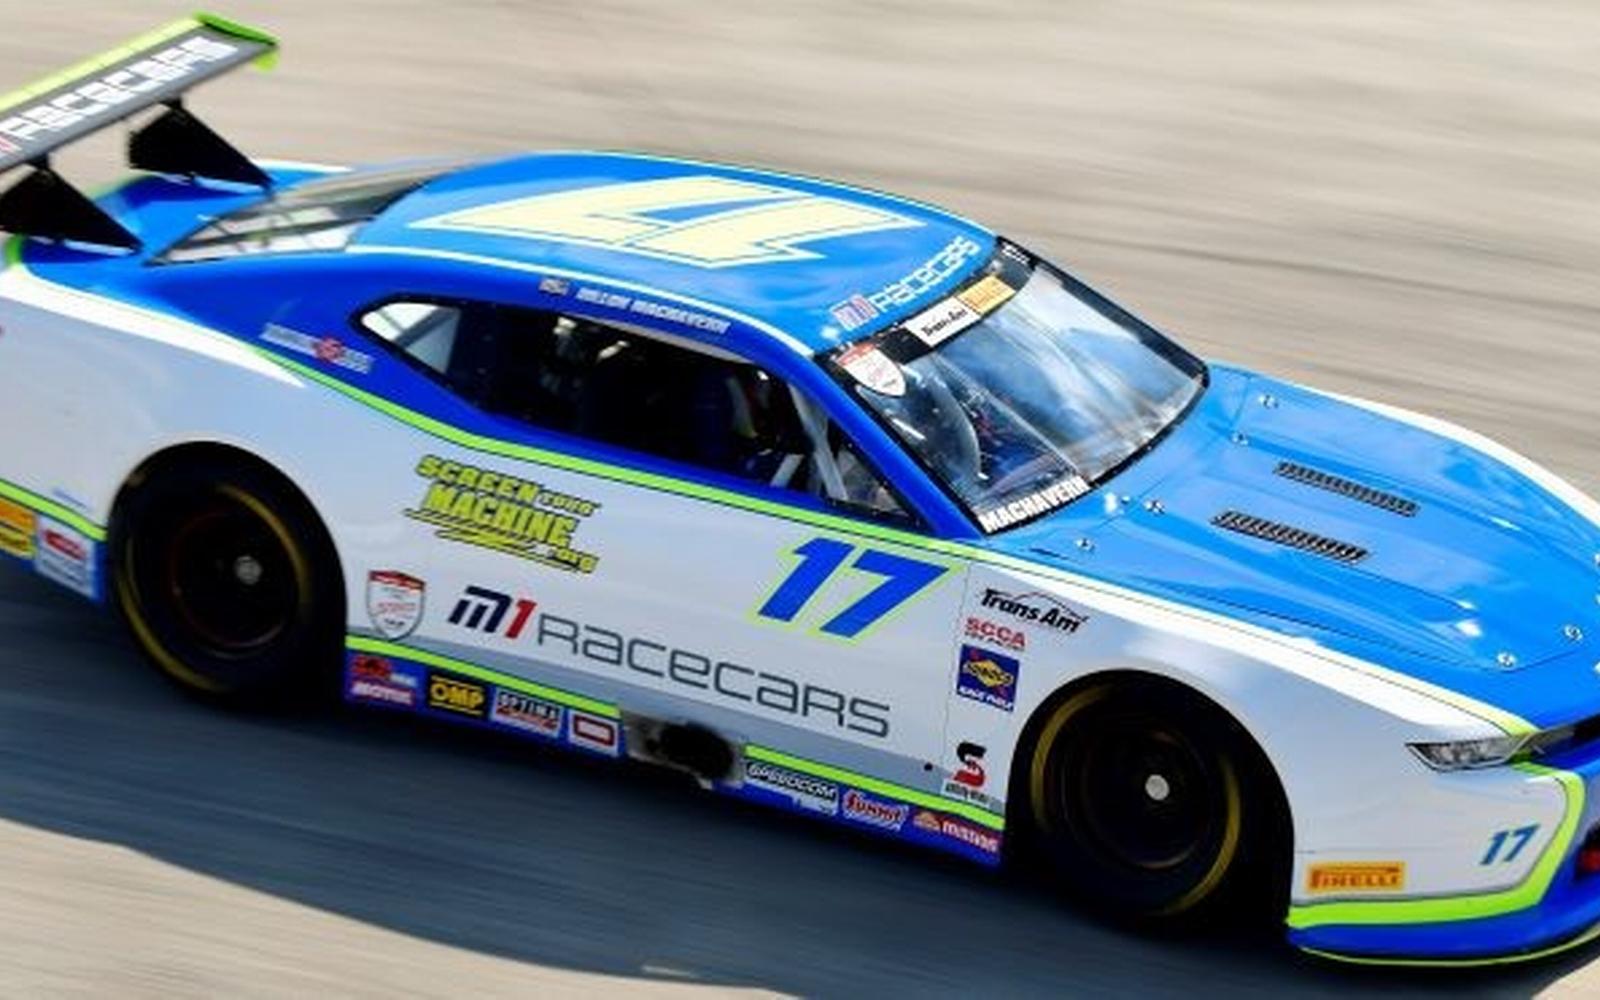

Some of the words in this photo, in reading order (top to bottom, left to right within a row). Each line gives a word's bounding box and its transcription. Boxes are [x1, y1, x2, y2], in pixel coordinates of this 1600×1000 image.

[416, 455, 543, 502] SCREEN
[422, 481, 579, 547] MACHINE
[750, 533, 958, 642] 17
[981, 588, 1041, 620] Trans
[1039, 607, 1081, 632] Am
[966, 617, 1025, 648] SCCA
[431, 682, 484, 709] OMP
[1479, 823, 1541, 866] 17
